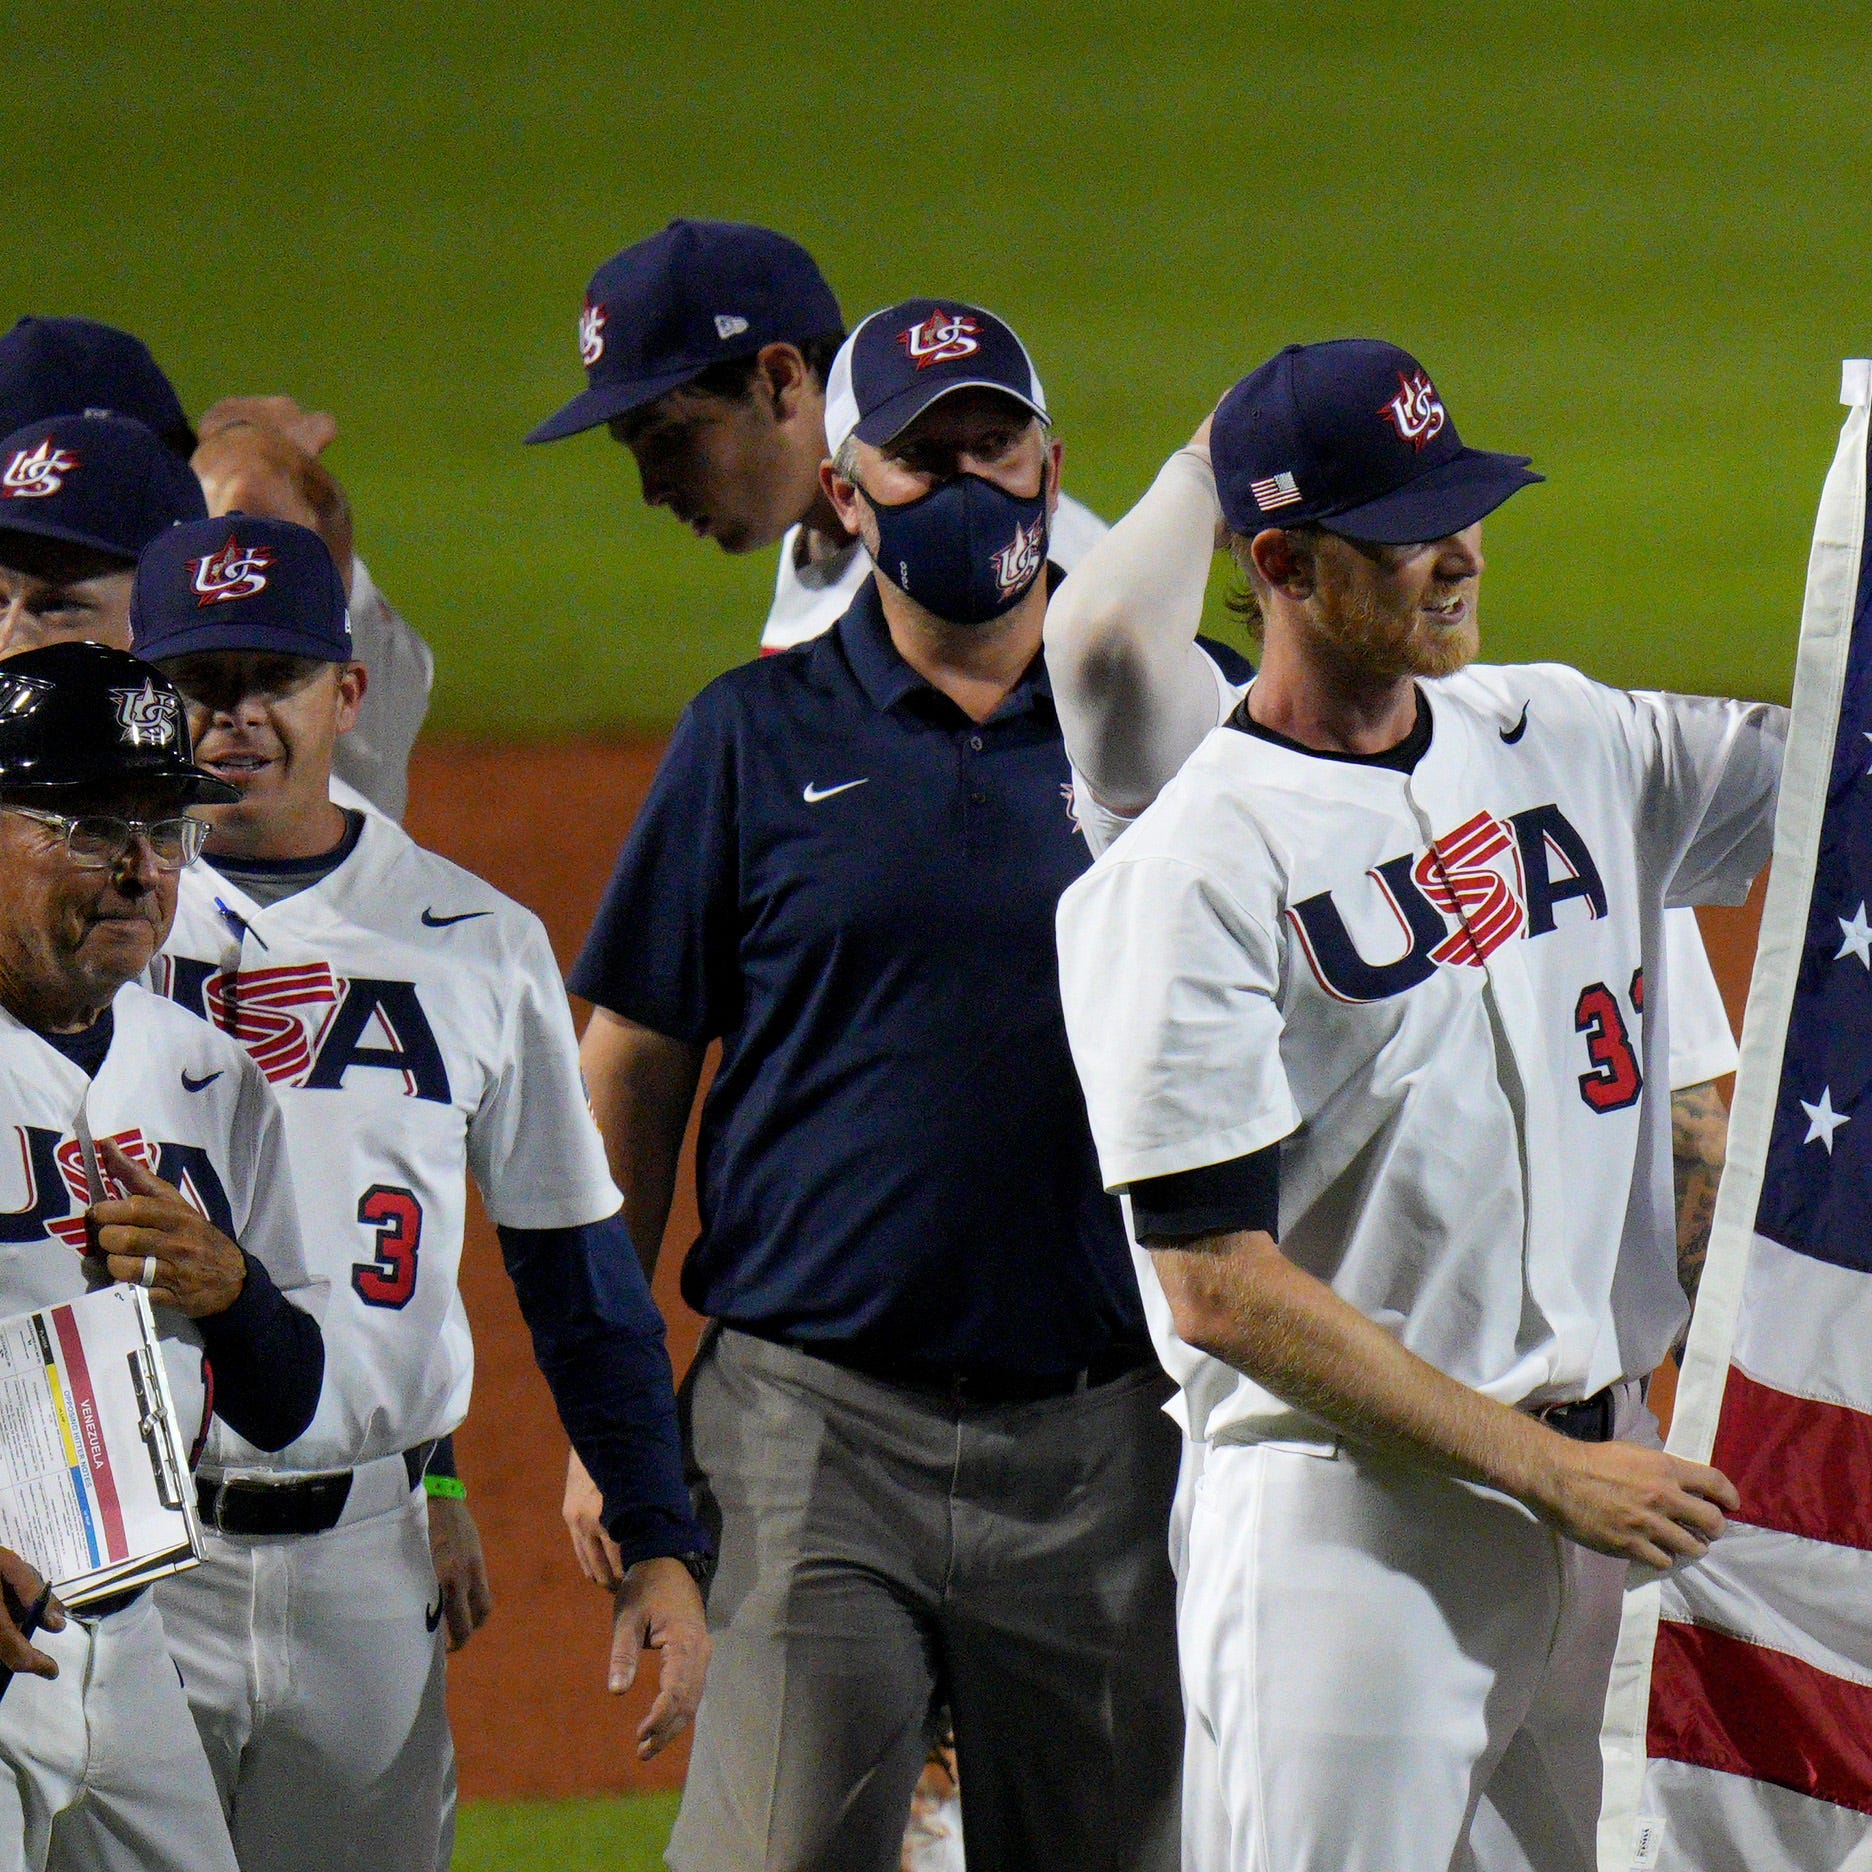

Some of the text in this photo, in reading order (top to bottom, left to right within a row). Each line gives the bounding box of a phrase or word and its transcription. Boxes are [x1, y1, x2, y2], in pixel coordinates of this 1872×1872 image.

[1284, 803, 1609, 1003] USA
[350, 1183, 424, 1311] 3
[79, 1398, 105, 1470] VENEZUELA
